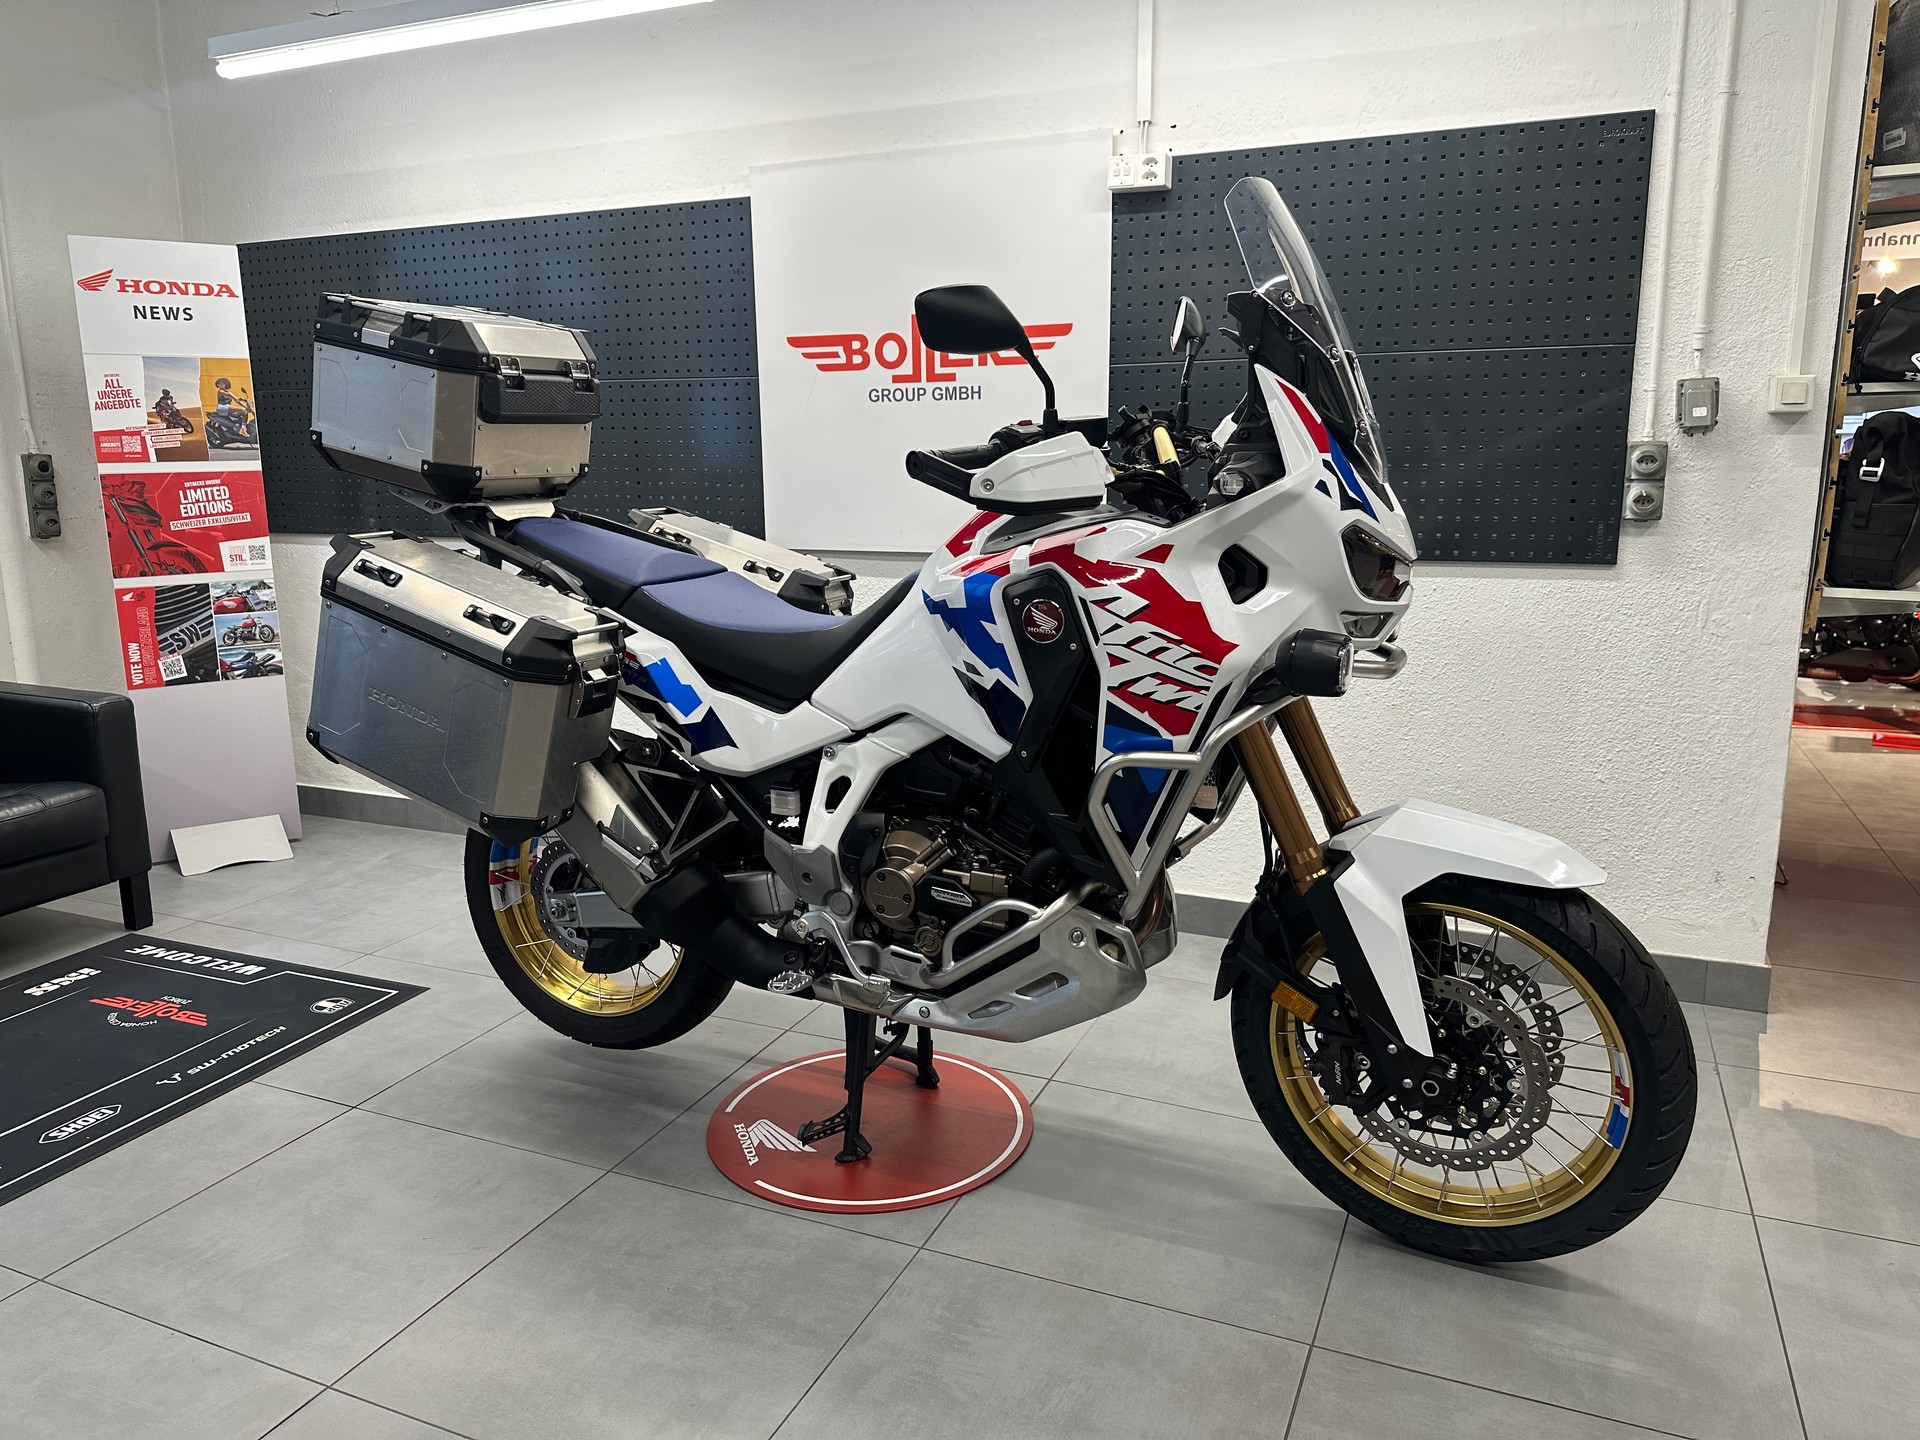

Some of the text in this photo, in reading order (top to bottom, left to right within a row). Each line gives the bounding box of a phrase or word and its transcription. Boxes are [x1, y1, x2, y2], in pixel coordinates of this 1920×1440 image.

[116, 278, 239, 298] HONDA
[133, 305, 194, 321] NEWS
[105, 378, 123, 389] ALL
[97, 389, 133, 400] UNSERE
[868, 385, 982, 403] GROUP GMBH
[94, 399, 141, 411] ANGEBOTE
[179, 486, 230, 504] LIMITED
[180, 500, 234, 517] EDITIONS
[171, 519, 207, 530] SCHWEIZER
[1027, 626, 1057, 635] HONDA
[127, 642, 144, 686] VOTE NOW
[368, 686, 445, 733] HONDA
[125, 944, 267, 976] WELCOME
[186, 1024, 287, 1076] SW-MOTECH
[48, 1108, 115, 1139] SHOEI
[733, 1122, 760, 1167] HONDA
